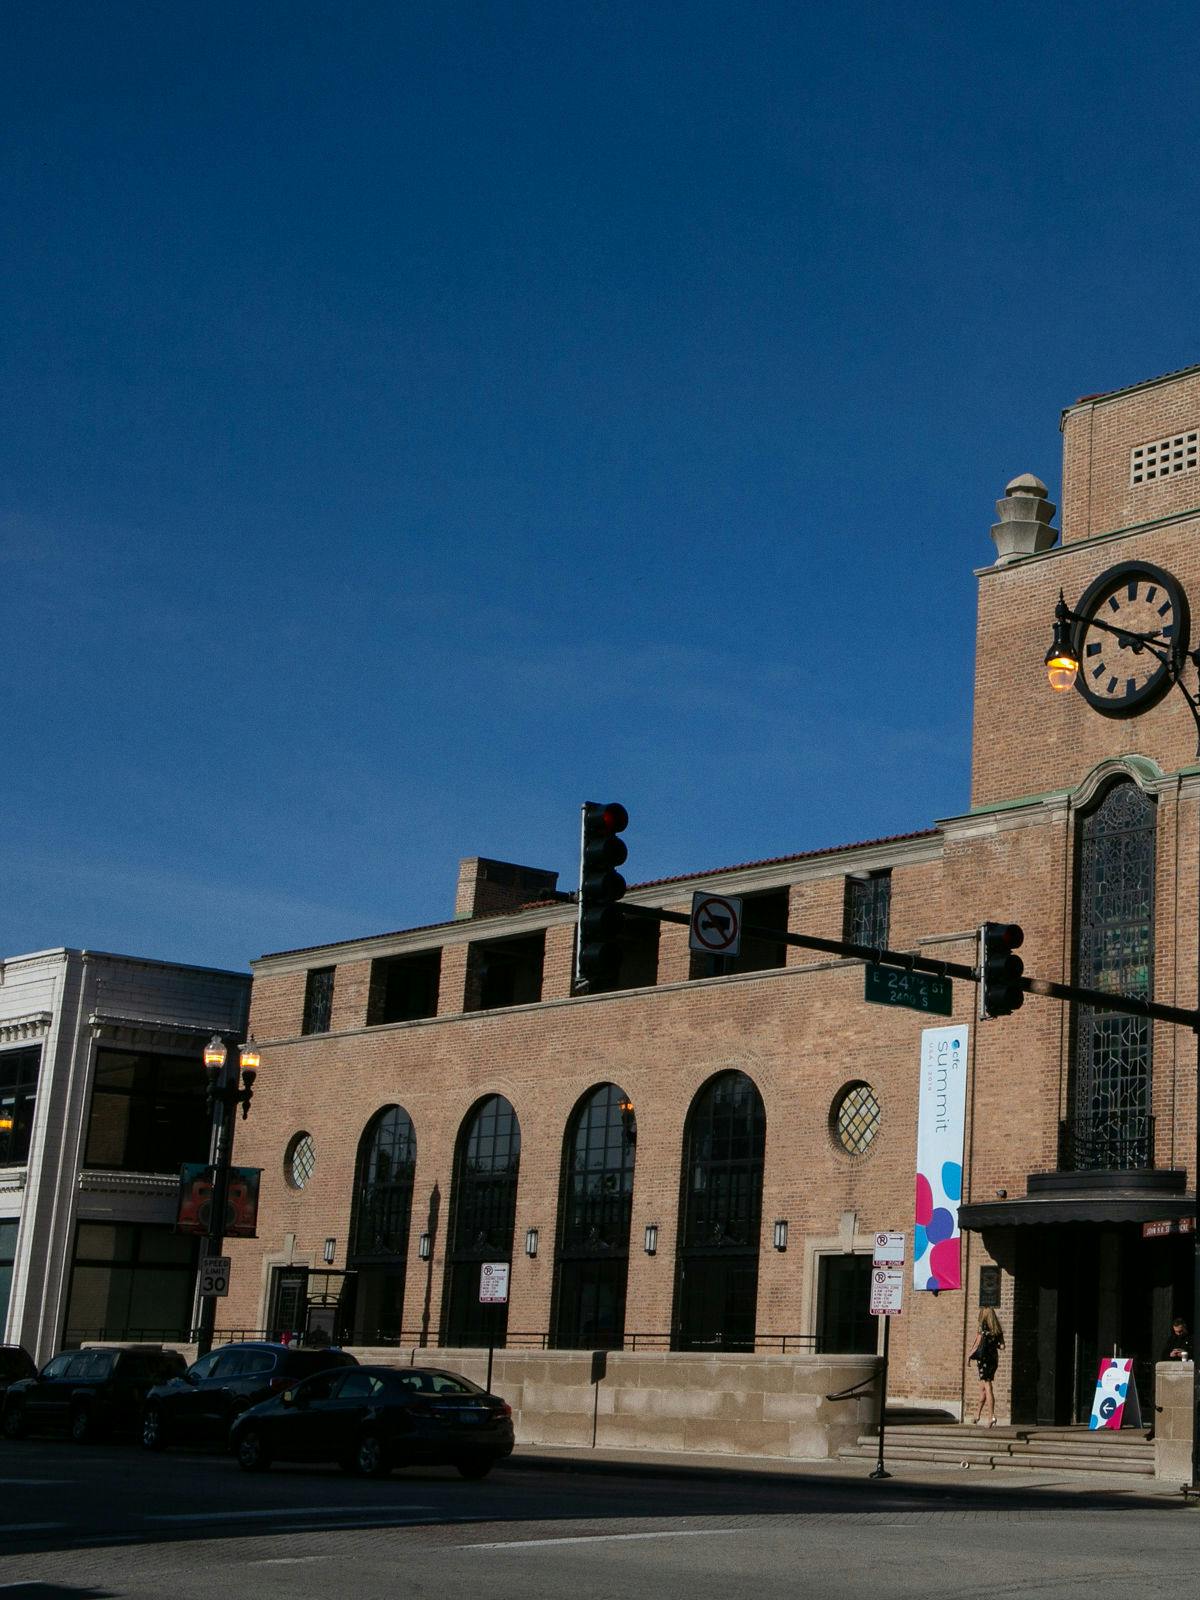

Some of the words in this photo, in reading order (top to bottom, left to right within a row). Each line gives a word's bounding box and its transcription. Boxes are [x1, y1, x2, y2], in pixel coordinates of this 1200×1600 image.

[873, 971, 880, 983] E
[952, 1051, 960, 1070] cfc
[936, 1041, 950, 1133] summit
[205, 1267, 224, 1275] LIMIT
[203, 1276, 226, 1291] 30
